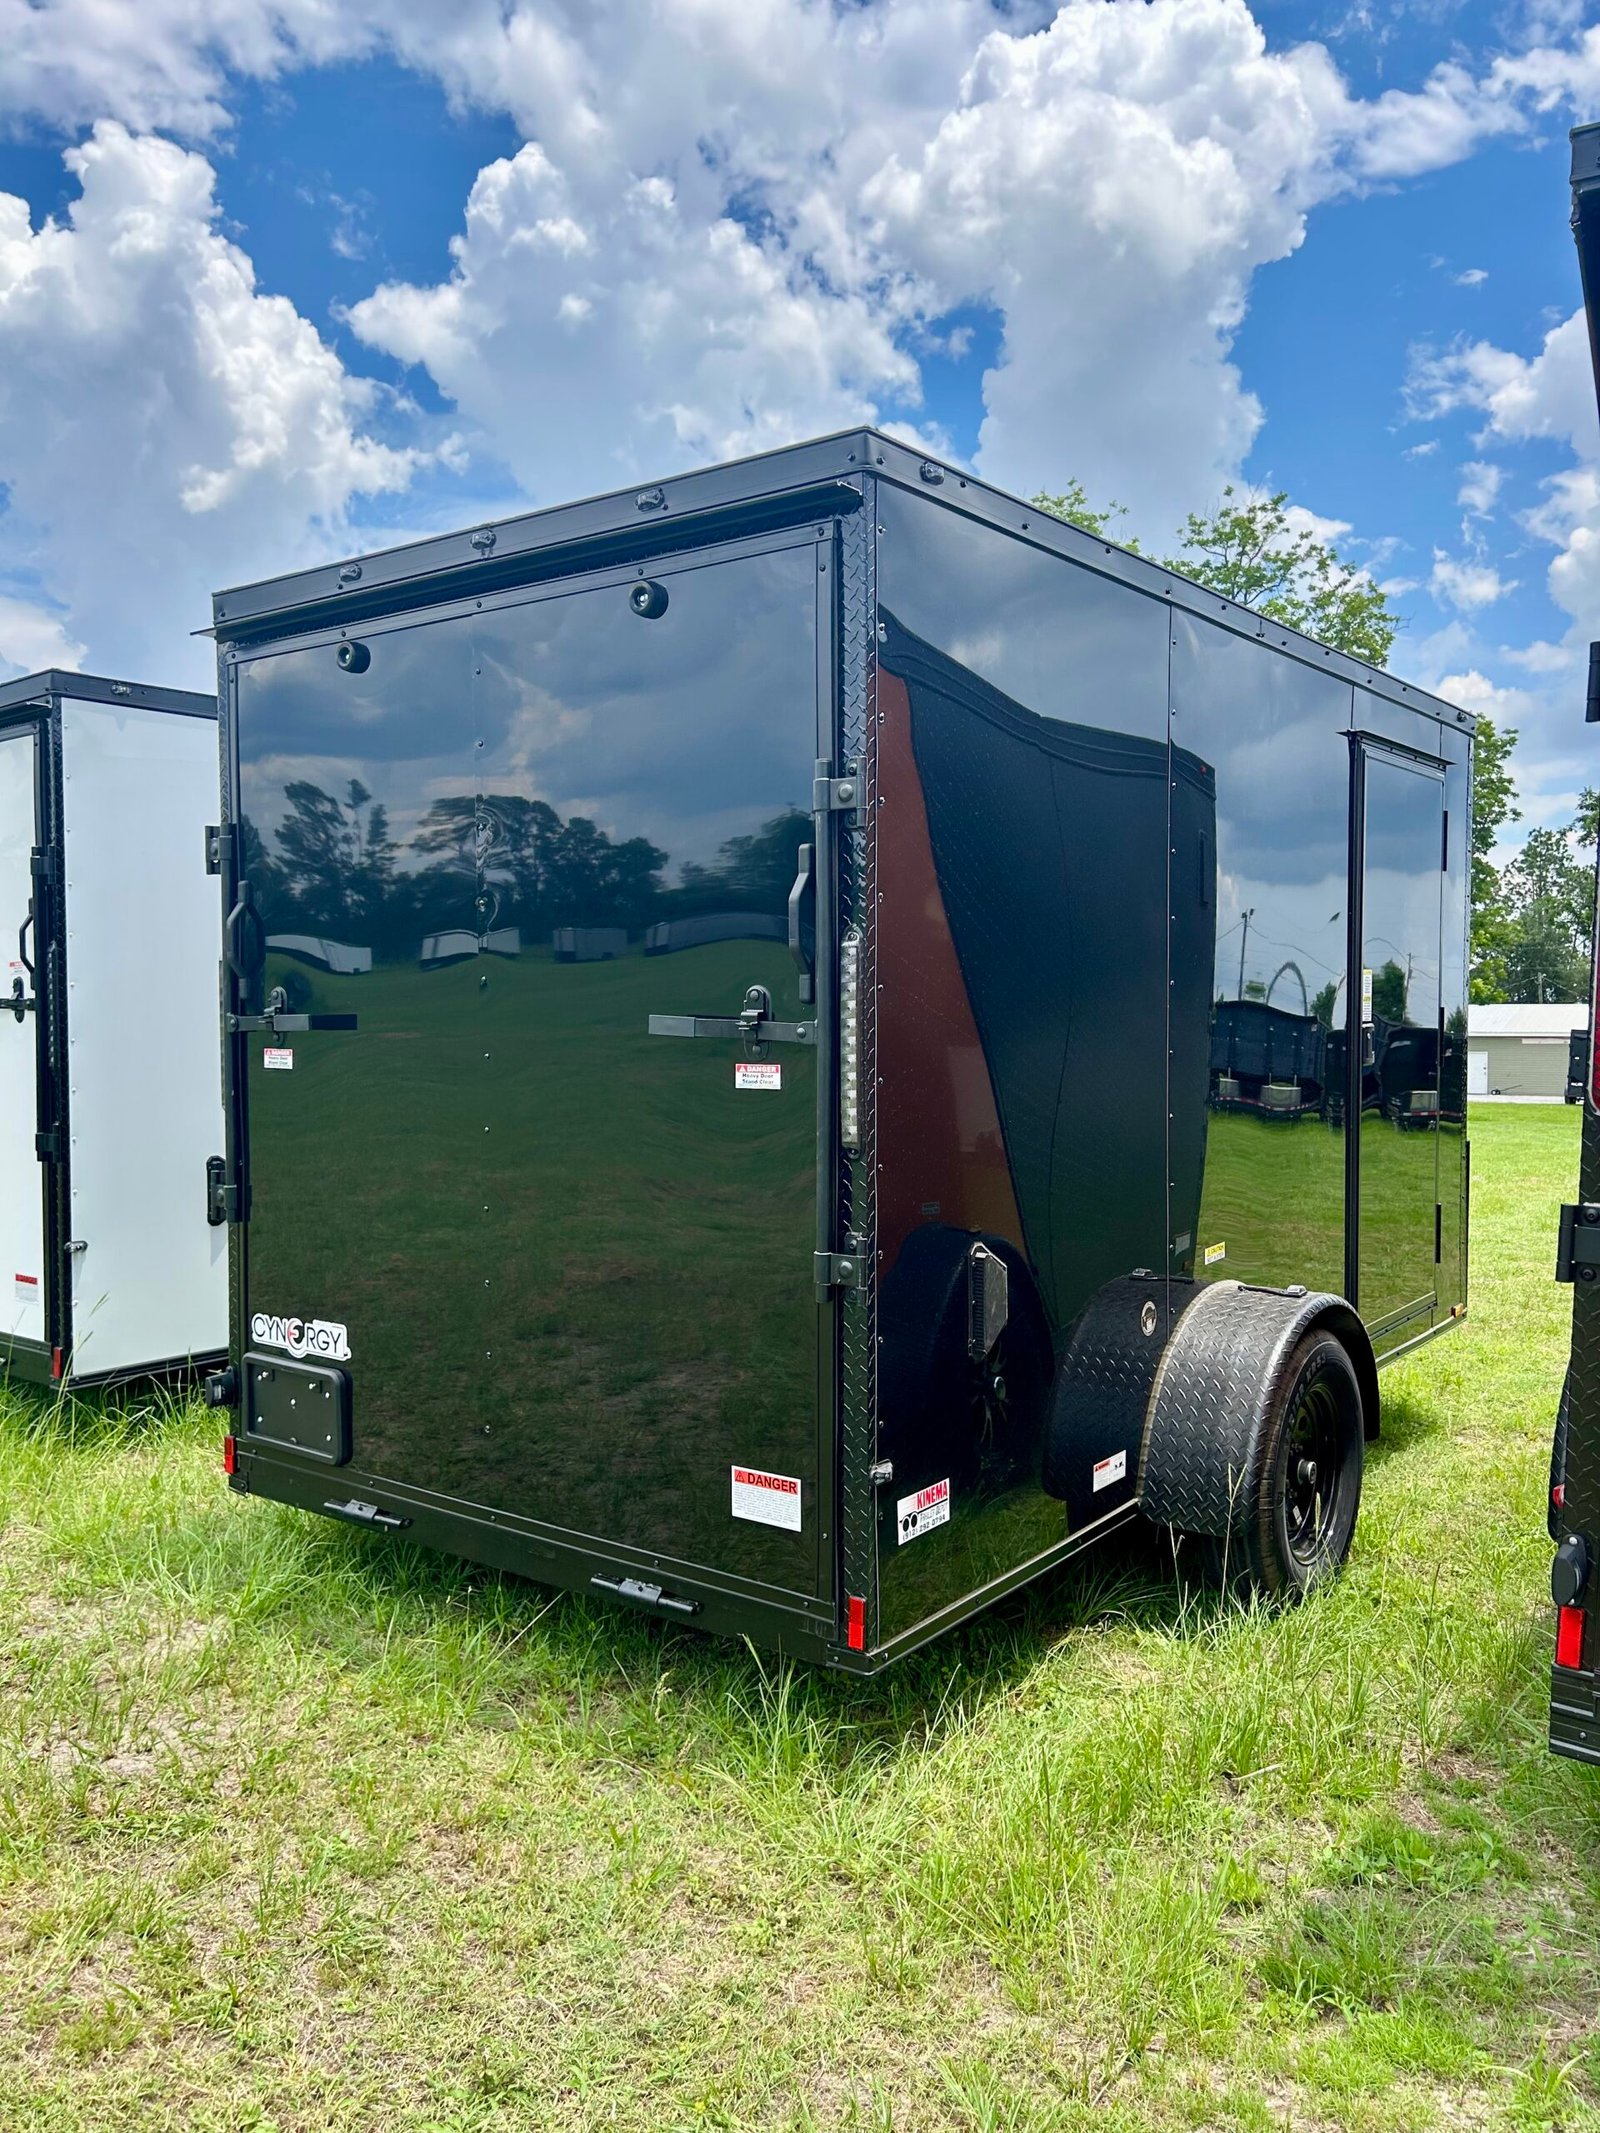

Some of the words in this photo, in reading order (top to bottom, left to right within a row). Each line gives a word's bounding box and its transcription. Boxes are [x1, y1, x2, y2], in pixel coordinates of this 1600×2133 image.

[253, 1316, 342, 1354] CYNERGY
[747, 1472, 798, 1494] DANGER
[916, 1480, 948, 1510] KINEMA
